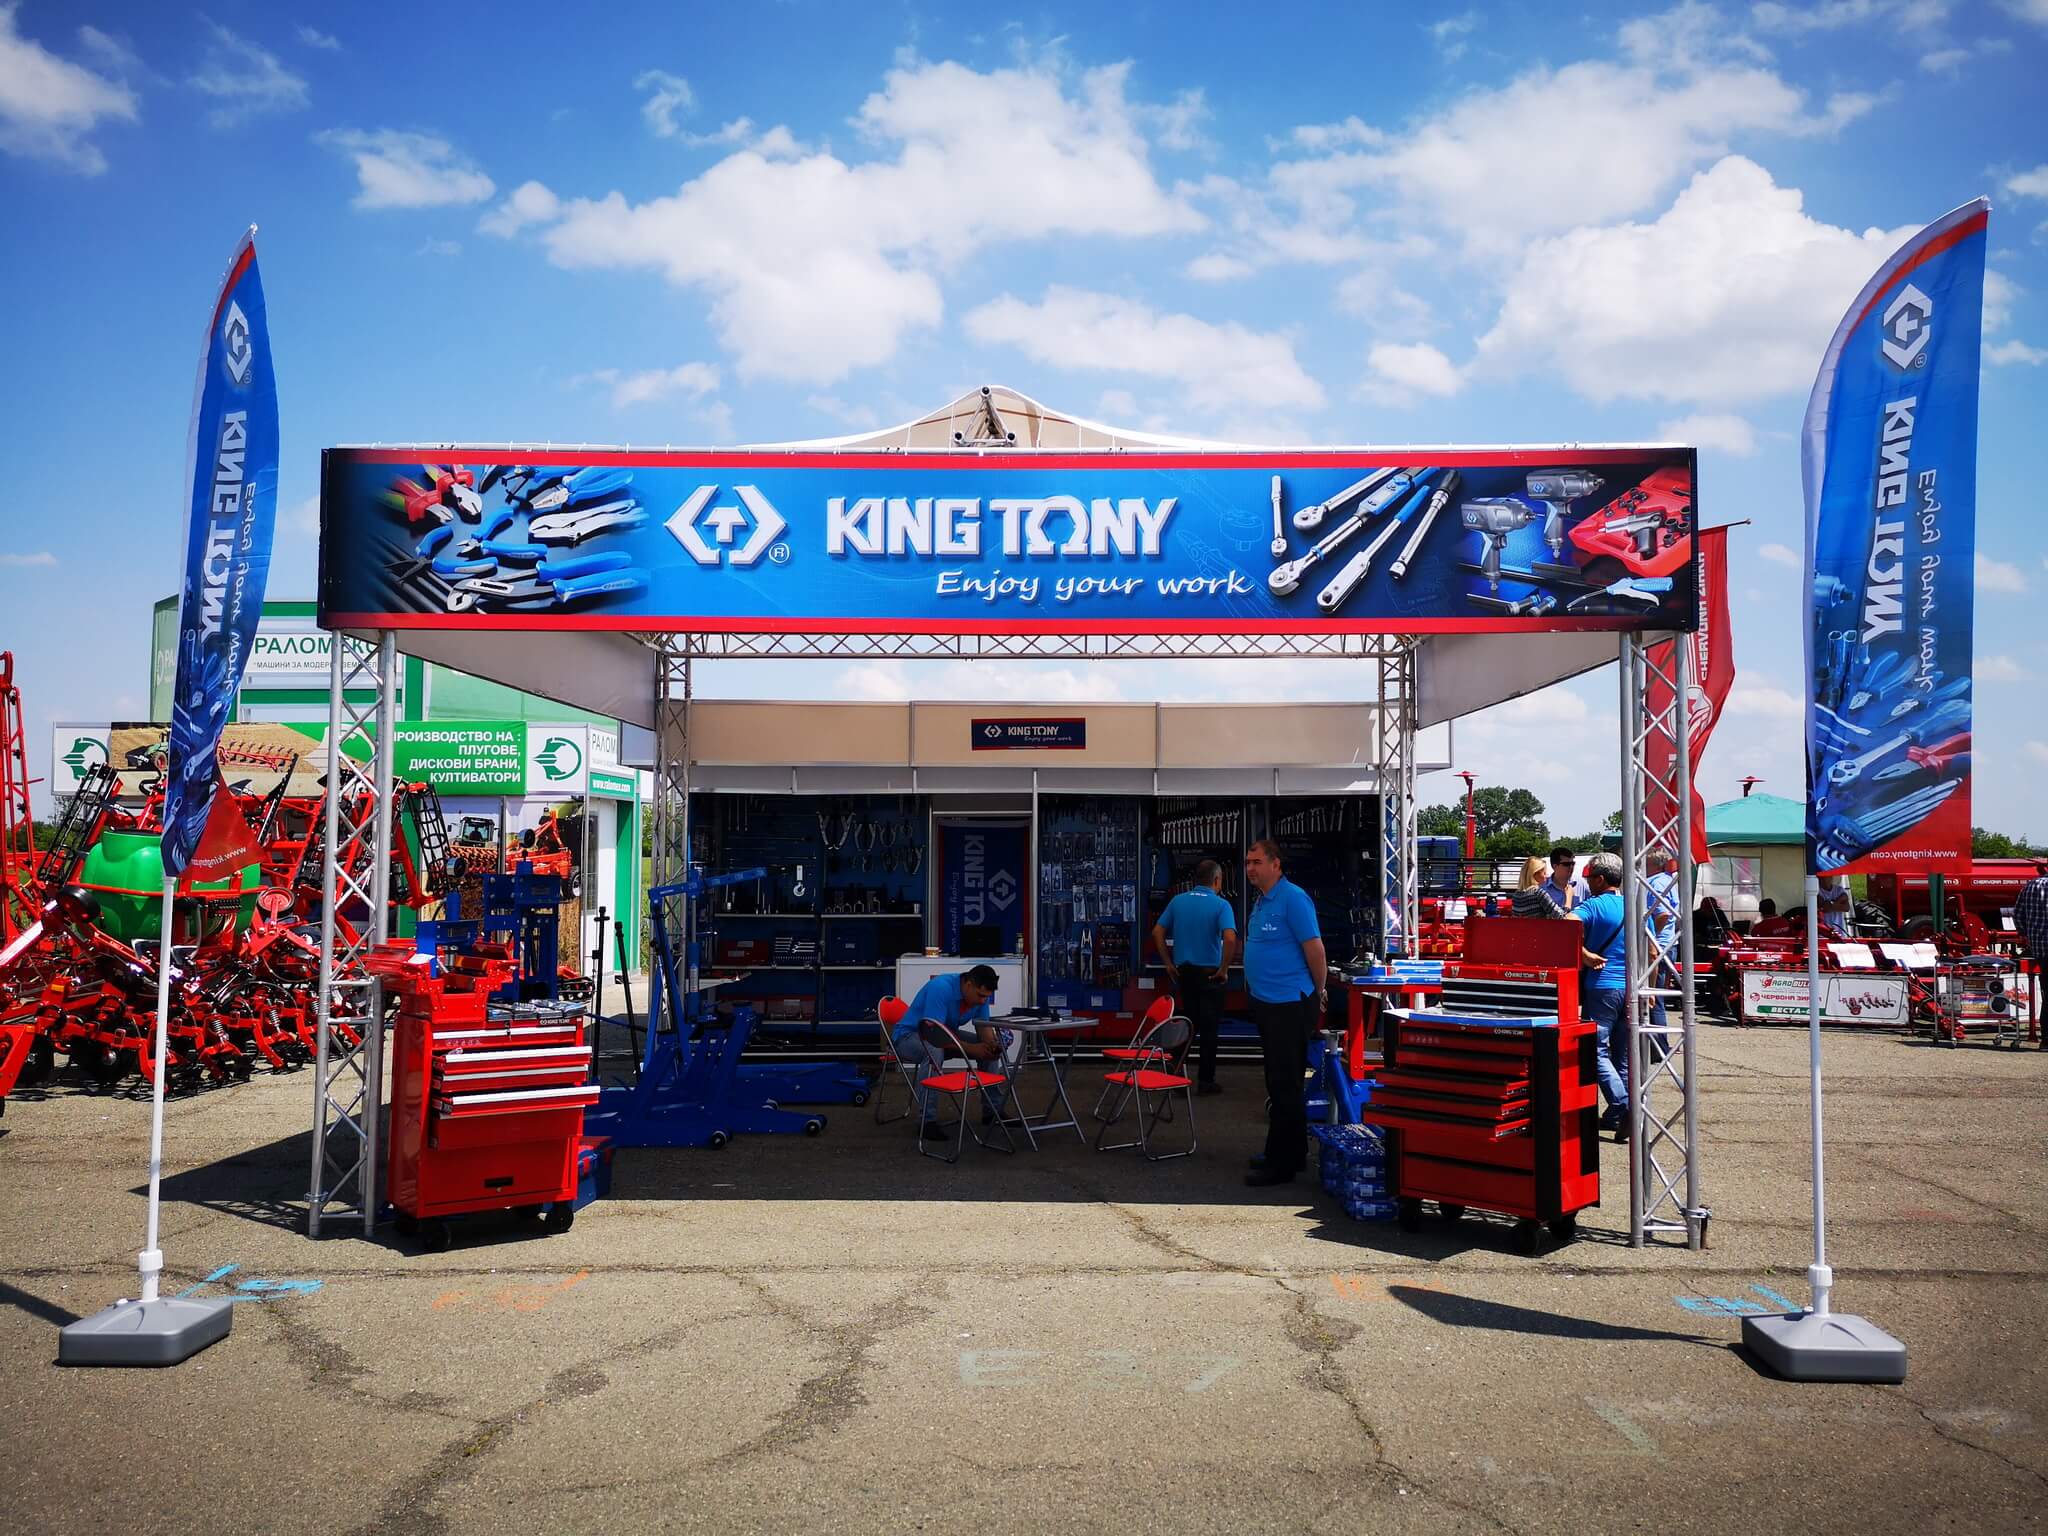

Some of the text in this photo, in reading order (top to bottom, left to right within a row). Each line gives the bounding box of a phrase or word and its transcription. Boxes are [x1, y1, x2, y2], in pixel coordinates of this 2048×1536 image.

[827, 495, 1178, 556] KING TONY
[936, 570, 1255, 600] Enjoy your work
[495, 731, 514, 742] НА
[1007, 725, 1060, 736] KING TONY
[458, 744, 521, 757] ПЛУГОВЕ,
[408, 758, 521, 771] ДИСКОВИ БРАНИ,
[429, 771, 521, 783] КУЛТИВАТОРИ
[964, 834, 986, 926] KING TO
